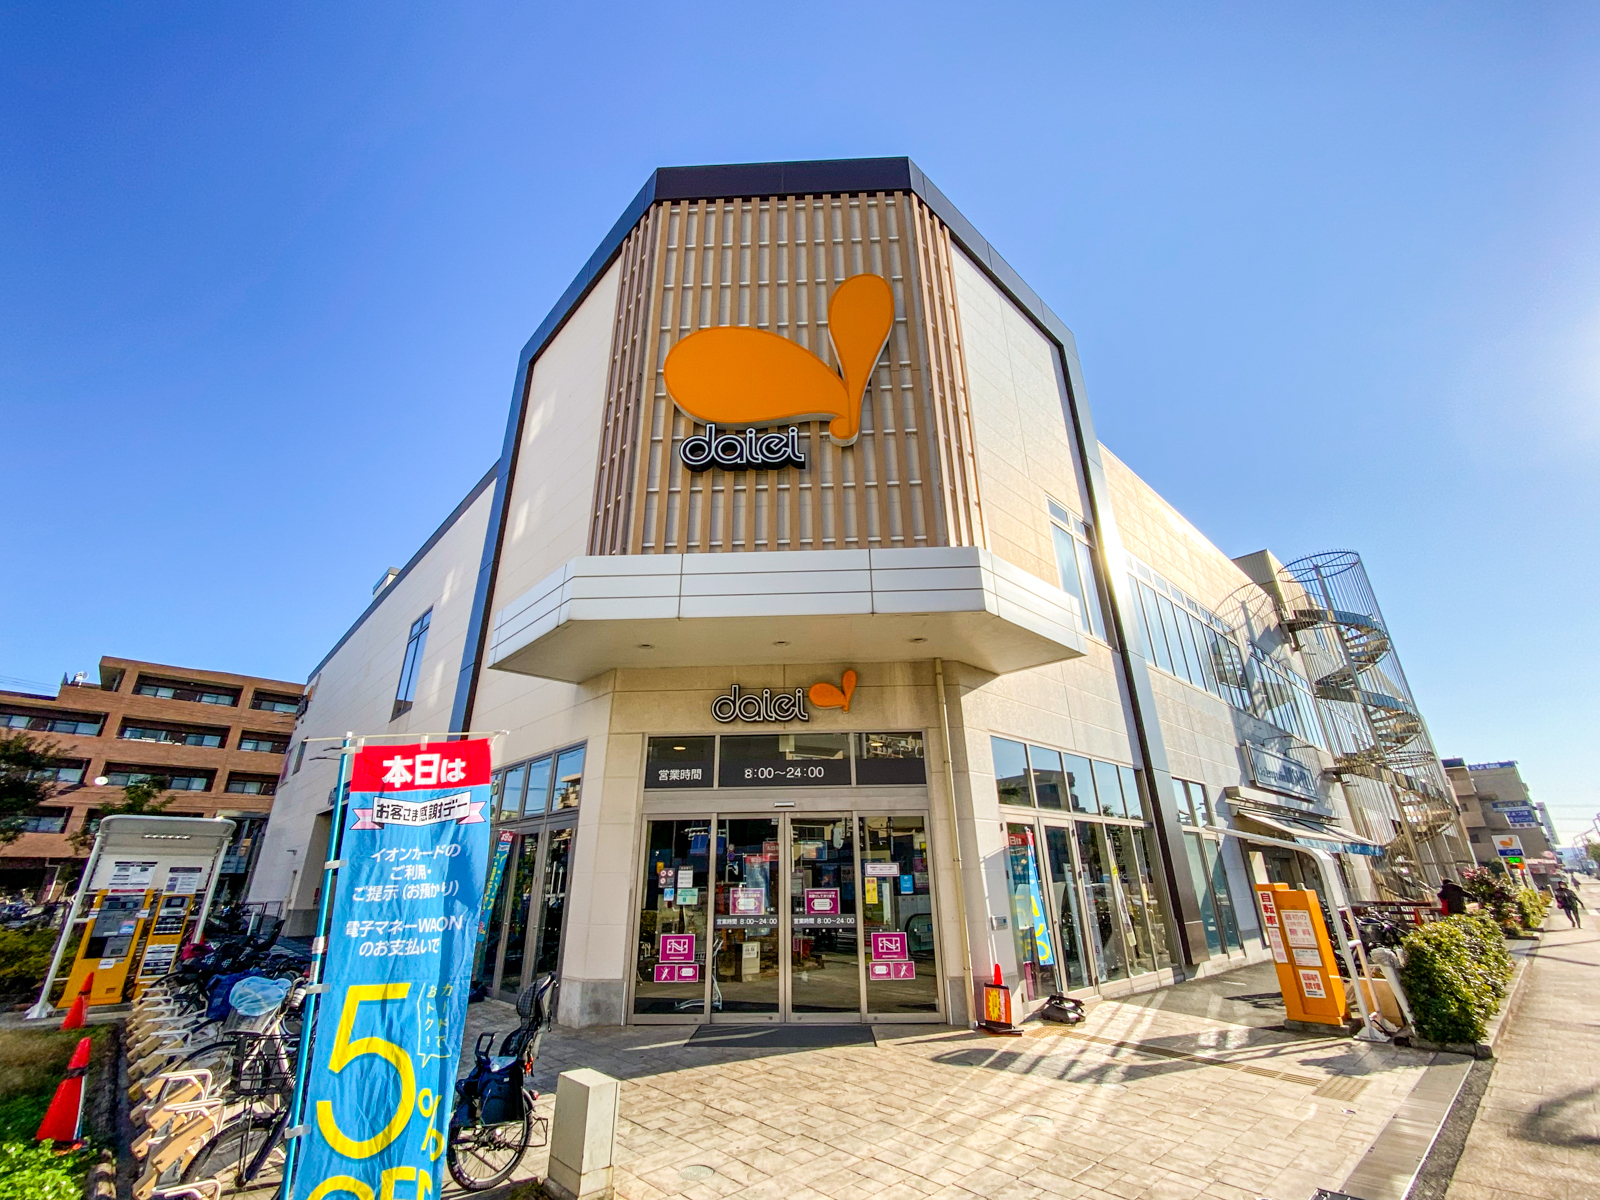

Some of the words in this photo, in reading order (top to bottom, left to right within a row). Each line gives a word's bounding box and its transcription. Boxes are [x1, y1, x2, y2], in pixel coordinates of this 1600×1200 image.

[680, 423, 805, 466] daiei
[711, 684, 809, 723] daiei
[382, 753, 466, 788] 本日は
[658, 768, 702, 781] 営業時間
[376, 798, 468, 822] お客さま感謝デー
[371, 843, 461, 862] イオンカードの
[1261, 892, 1277, 925] 自転車
[346, 915, 463, 938] 電子マネーWAON
[359, 937, 441, 957] のお支払いで
